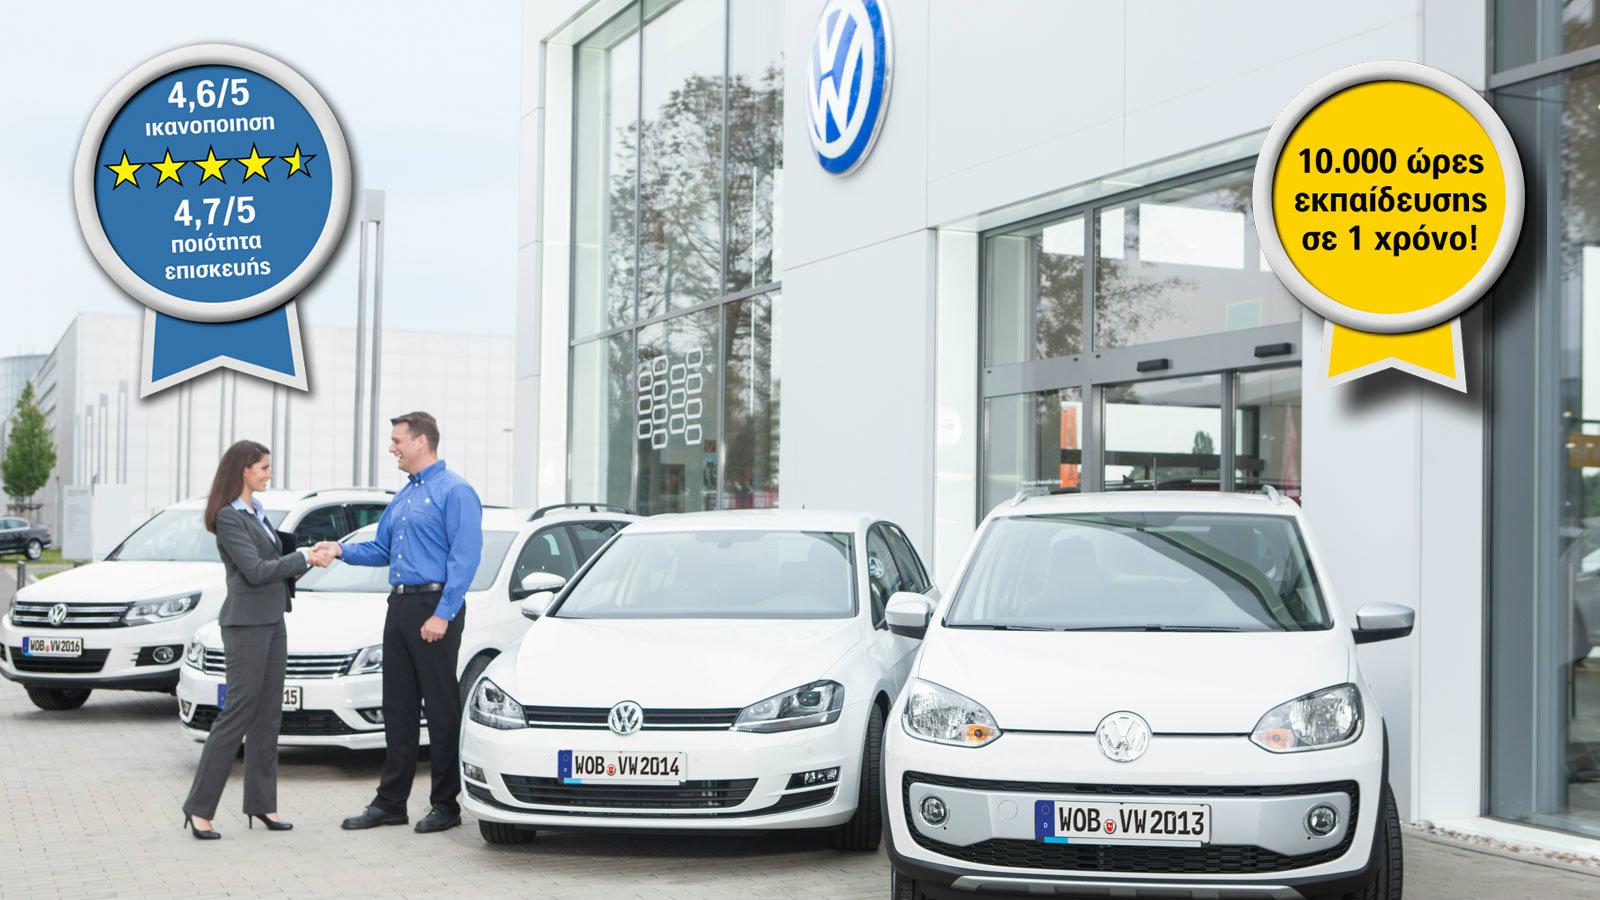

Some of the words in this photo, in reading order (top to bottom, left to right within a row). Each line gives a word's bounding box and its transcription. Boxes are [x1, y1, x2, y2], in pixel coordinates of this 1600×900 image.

[30, 639, 45, 652] WOB
[575, 755, 605, 775] WOB
[1058, 806, 1102, 833] WOB
